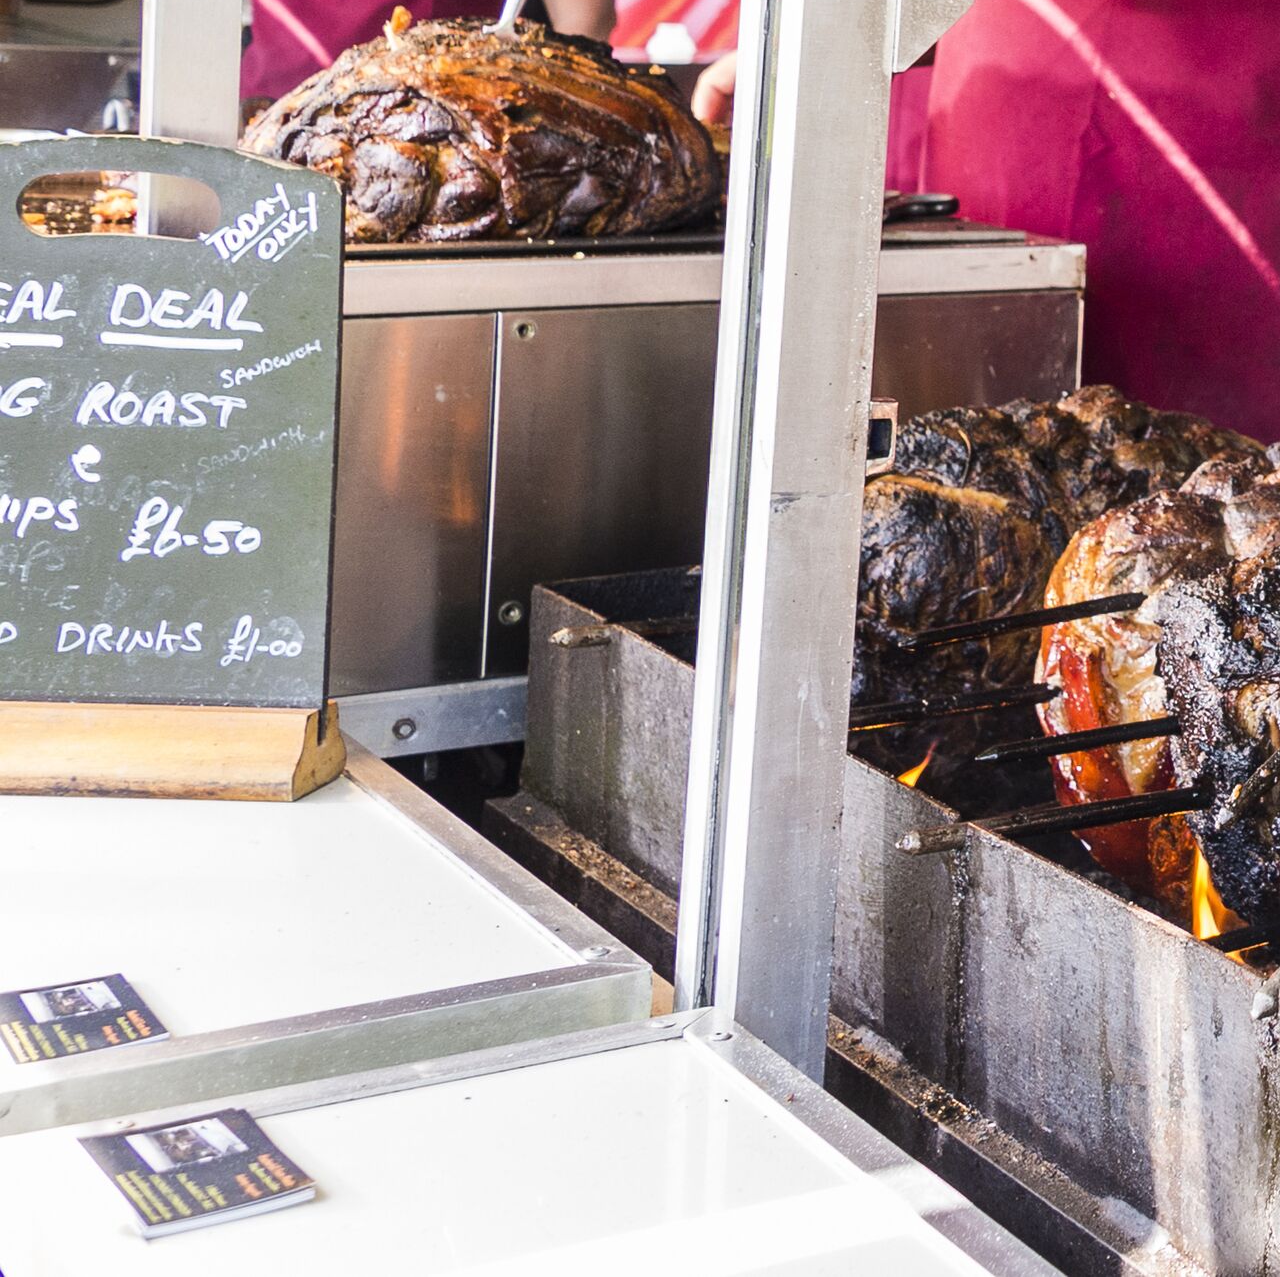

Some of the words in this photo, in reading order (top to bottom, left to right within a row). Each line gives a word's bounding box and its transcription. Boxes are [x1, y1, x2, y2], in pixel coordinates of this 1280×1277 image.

[203, 182, 290, 260] TODAY
[257, 191, 318, 260] ONLY
[109, 283, 265, 333] DEAL
[220, 339, 323, 389] SANDWICH
[76, 381, 248, 428] ROAST
[56, 618, 203, 655] DRINKS
